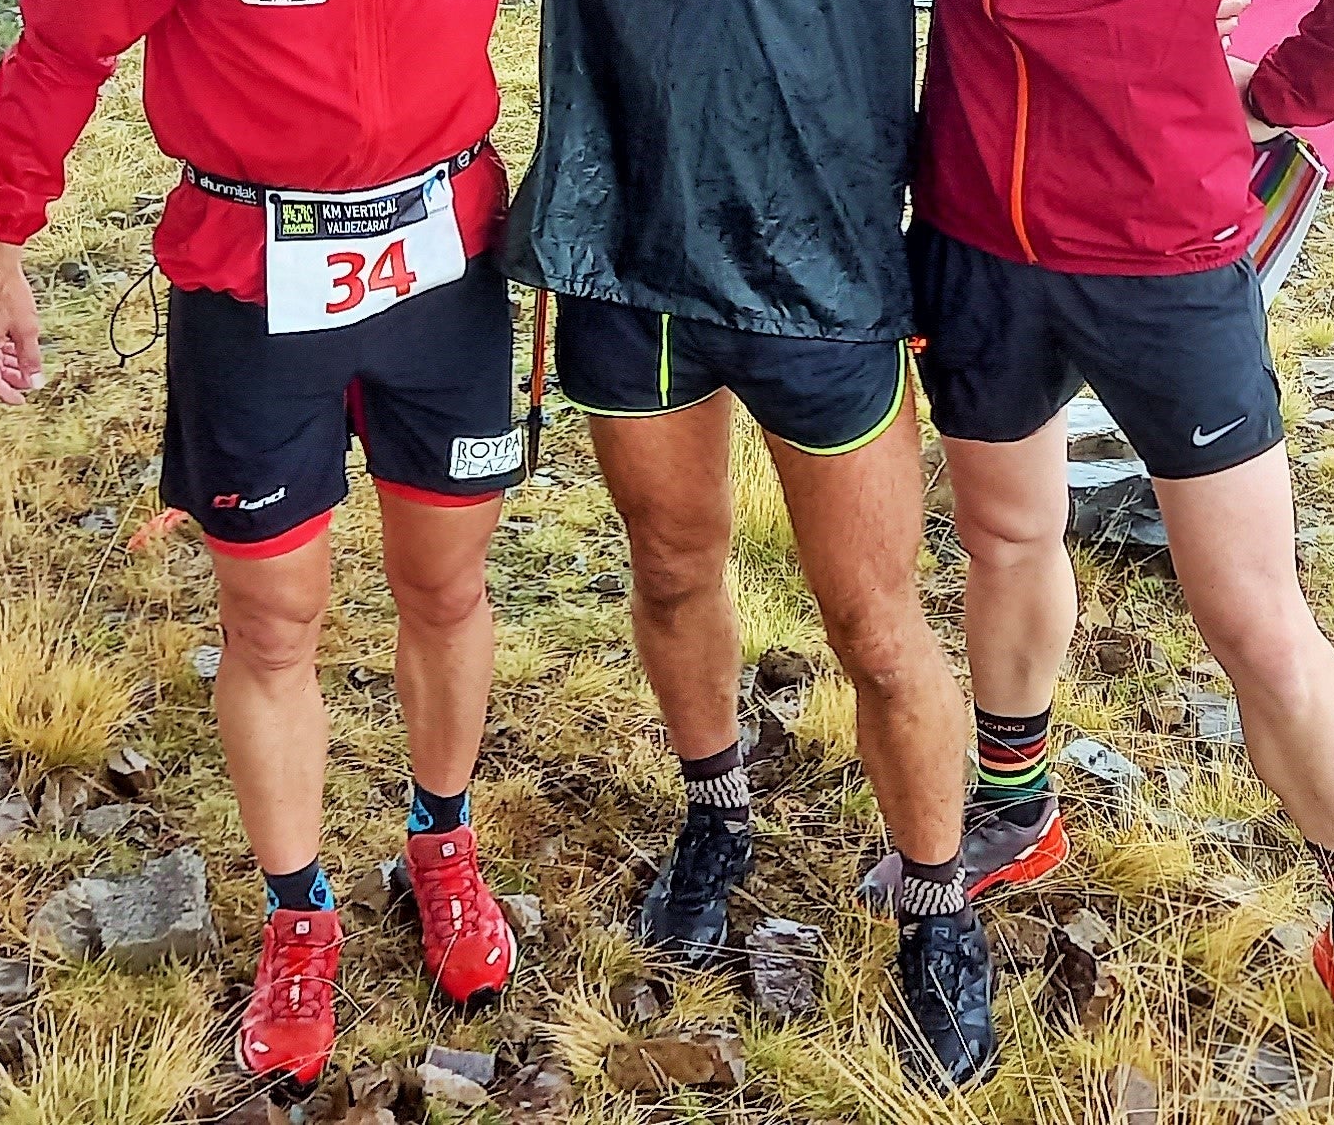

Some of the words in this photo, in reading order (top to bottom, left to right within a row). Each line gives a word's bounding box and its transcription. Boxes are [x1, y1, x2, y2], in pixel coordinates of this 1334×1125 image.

[322, 204, 342, 219] KM
[343, 198, 398, 219] VERTICAL
[327, 218, 390, 234] VALDEZCARAY
[326, 238, 417, 314] 34
[457, 433, 520, 459] ROYPA
[454, 451, 519, 476] PLAZA
